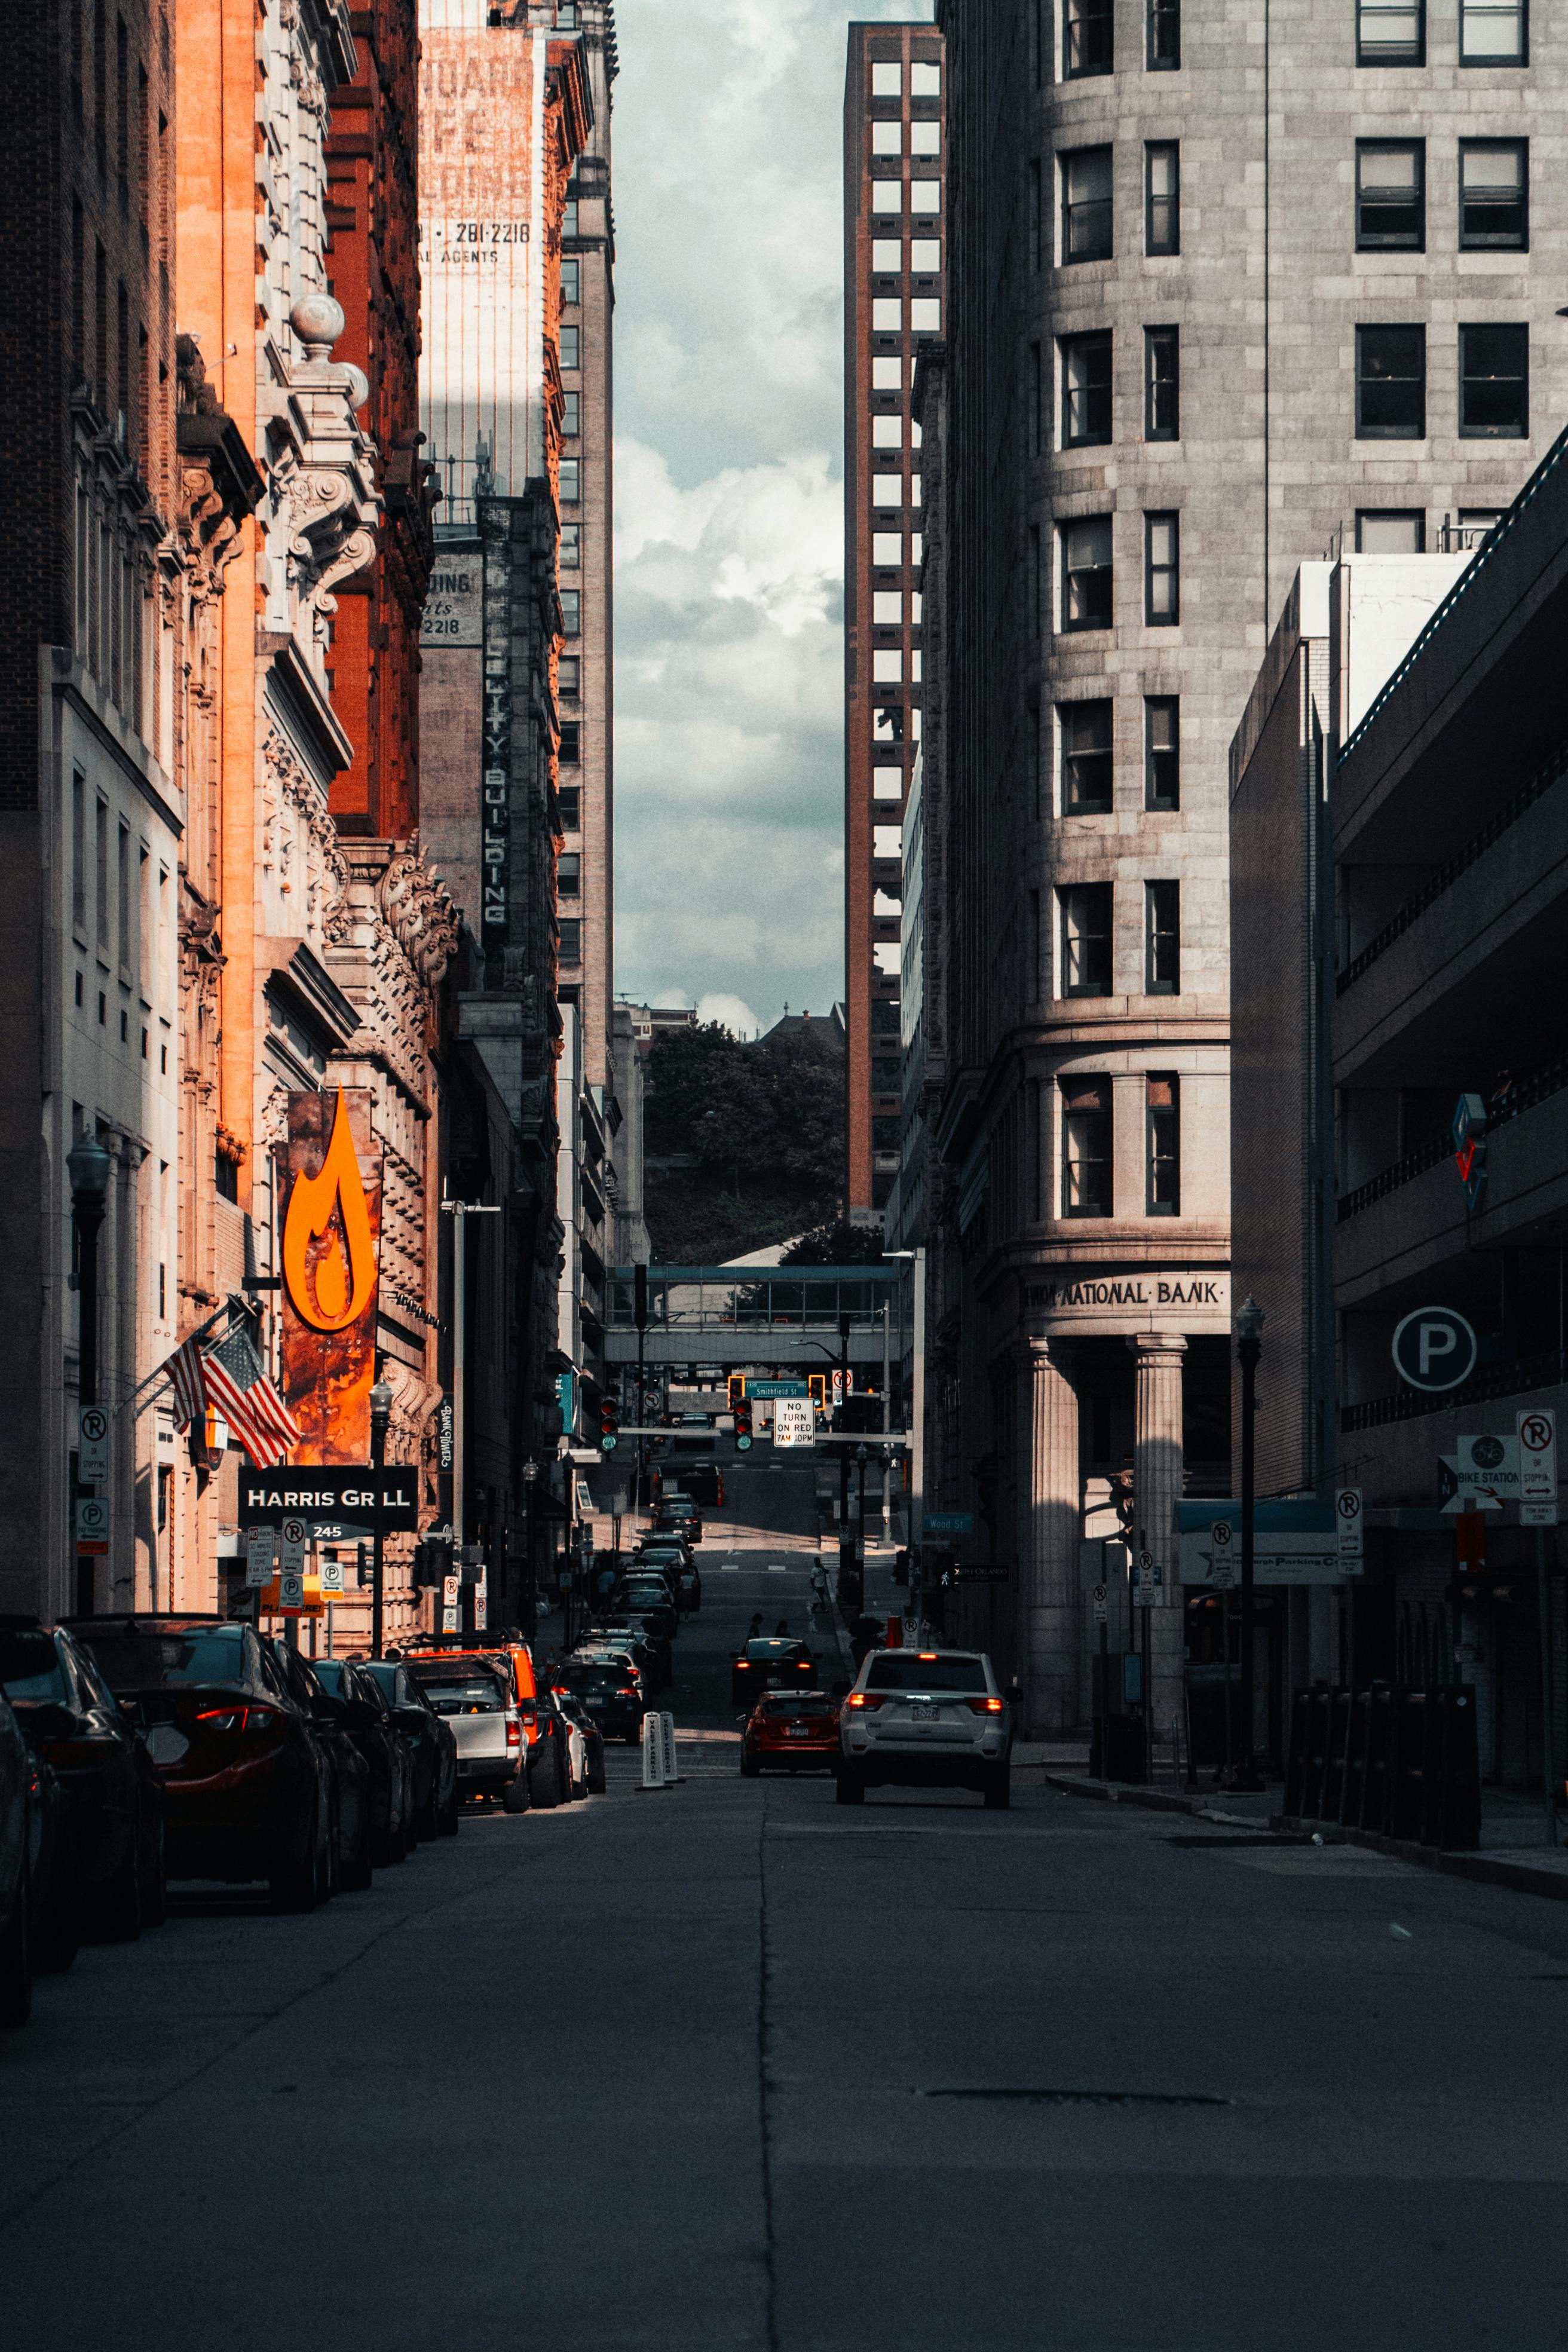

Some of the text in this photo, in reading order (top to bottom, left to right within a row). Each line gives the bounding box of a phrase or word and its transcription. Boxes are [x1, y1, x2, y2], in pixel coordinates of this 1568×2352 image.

[441, 250, 497, 263] AGENTS
[485, 768, 506, 923] BUILDING
[1061, 1282, 1149, 1306] NATIONAL
[1157, 1282, 1220, 1303] BANK
[1458, 1472, 1480, 1483] BIKE
[247, 1490, 411, 1506] HARRIS GRLL
[930, 1520, 963, 1529] Wood St
[313, 1526, 342, 1538] 245
[1275, 1557, 1321, 1567] Parking
